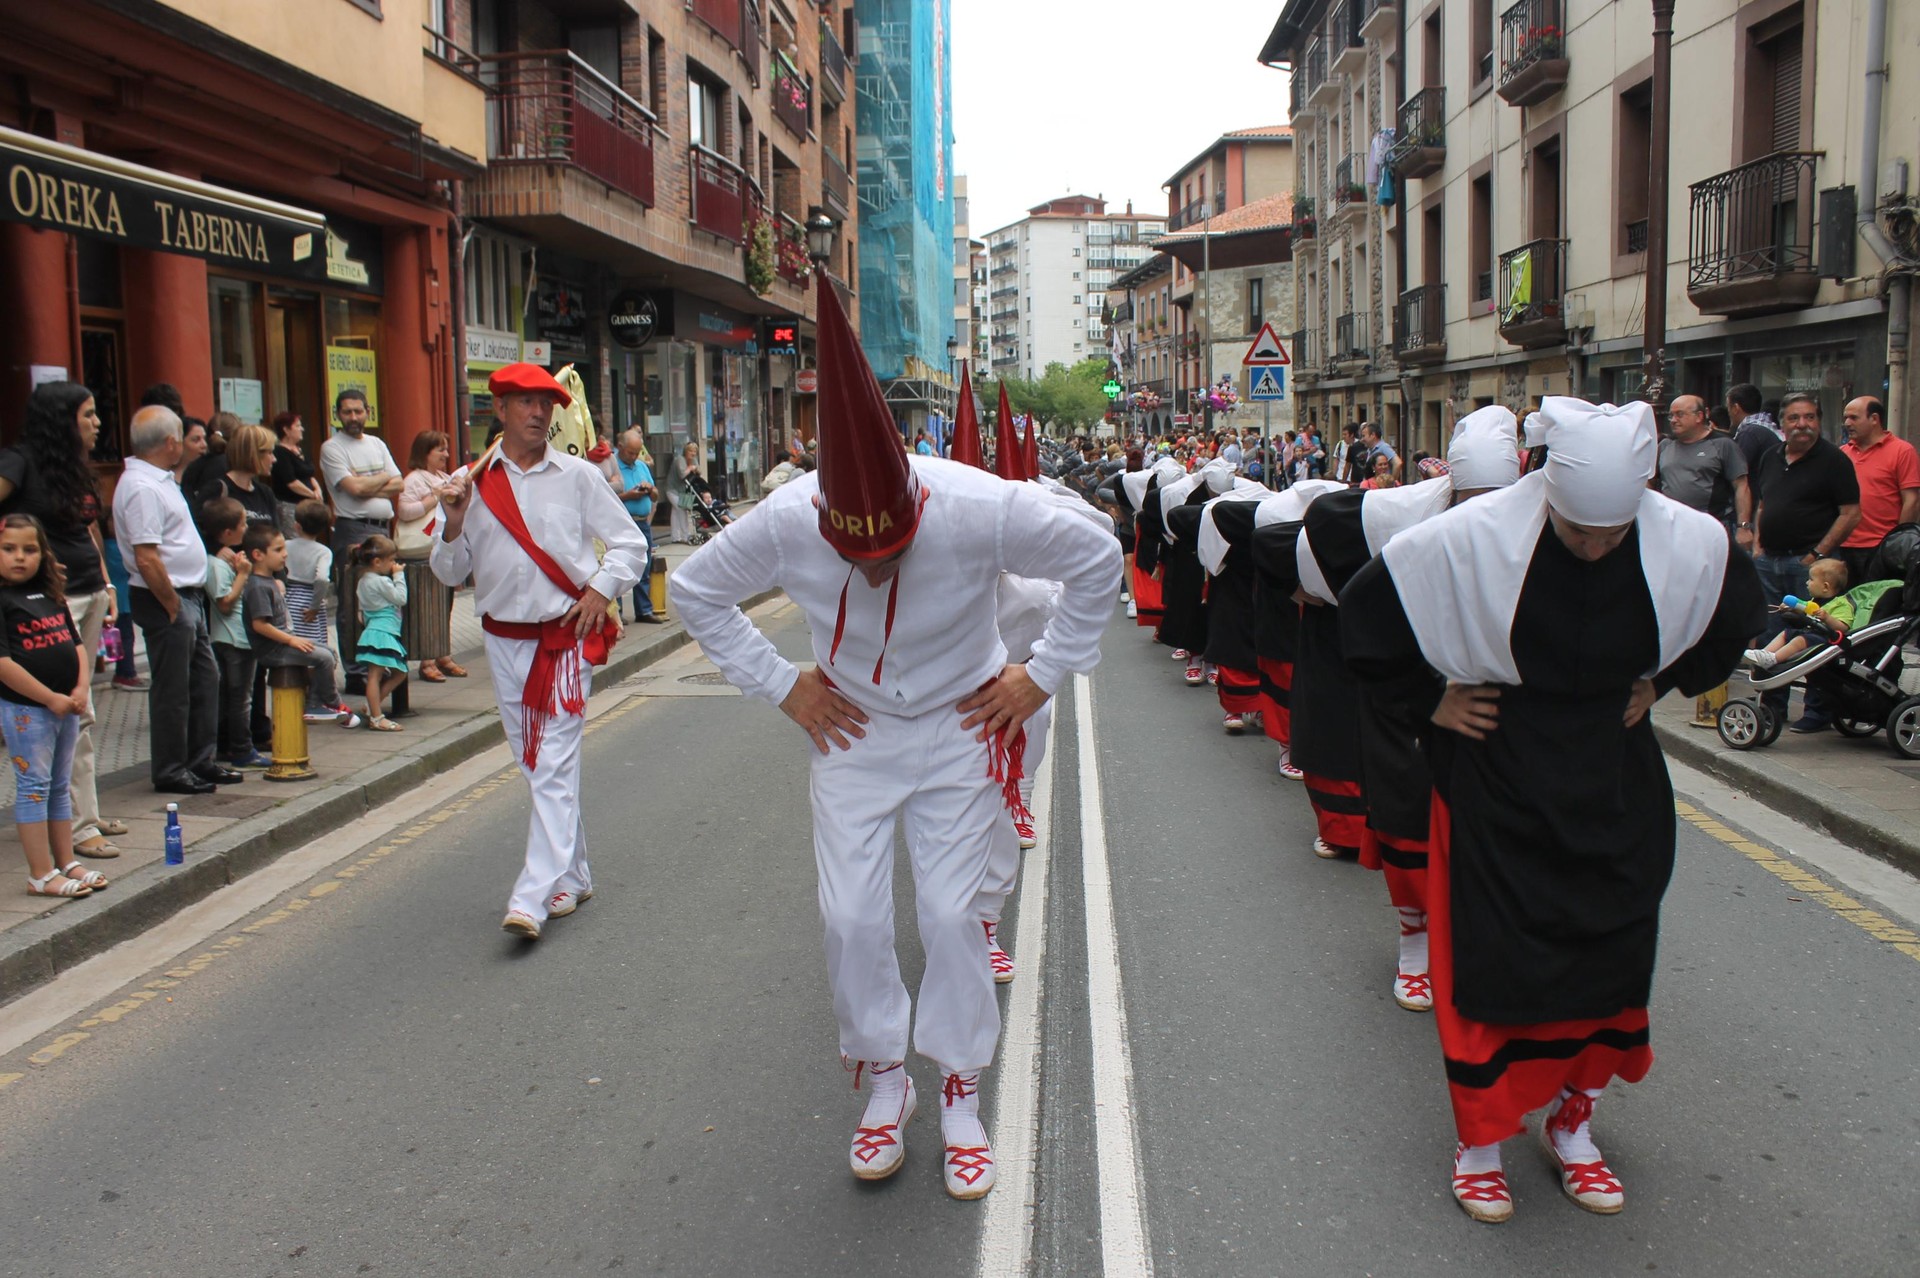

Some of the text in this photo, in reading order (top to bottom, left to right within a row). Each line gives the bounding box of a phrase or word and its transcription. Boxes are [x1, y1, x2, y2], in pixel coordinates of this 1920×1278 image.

[9, 164, 270, 263] OREKA TABERNA
[328, 262, 361, 278] IETETICA
[610, 314, 652, 326] GUINNESS
[830, 508, 894, 537] ORIA
